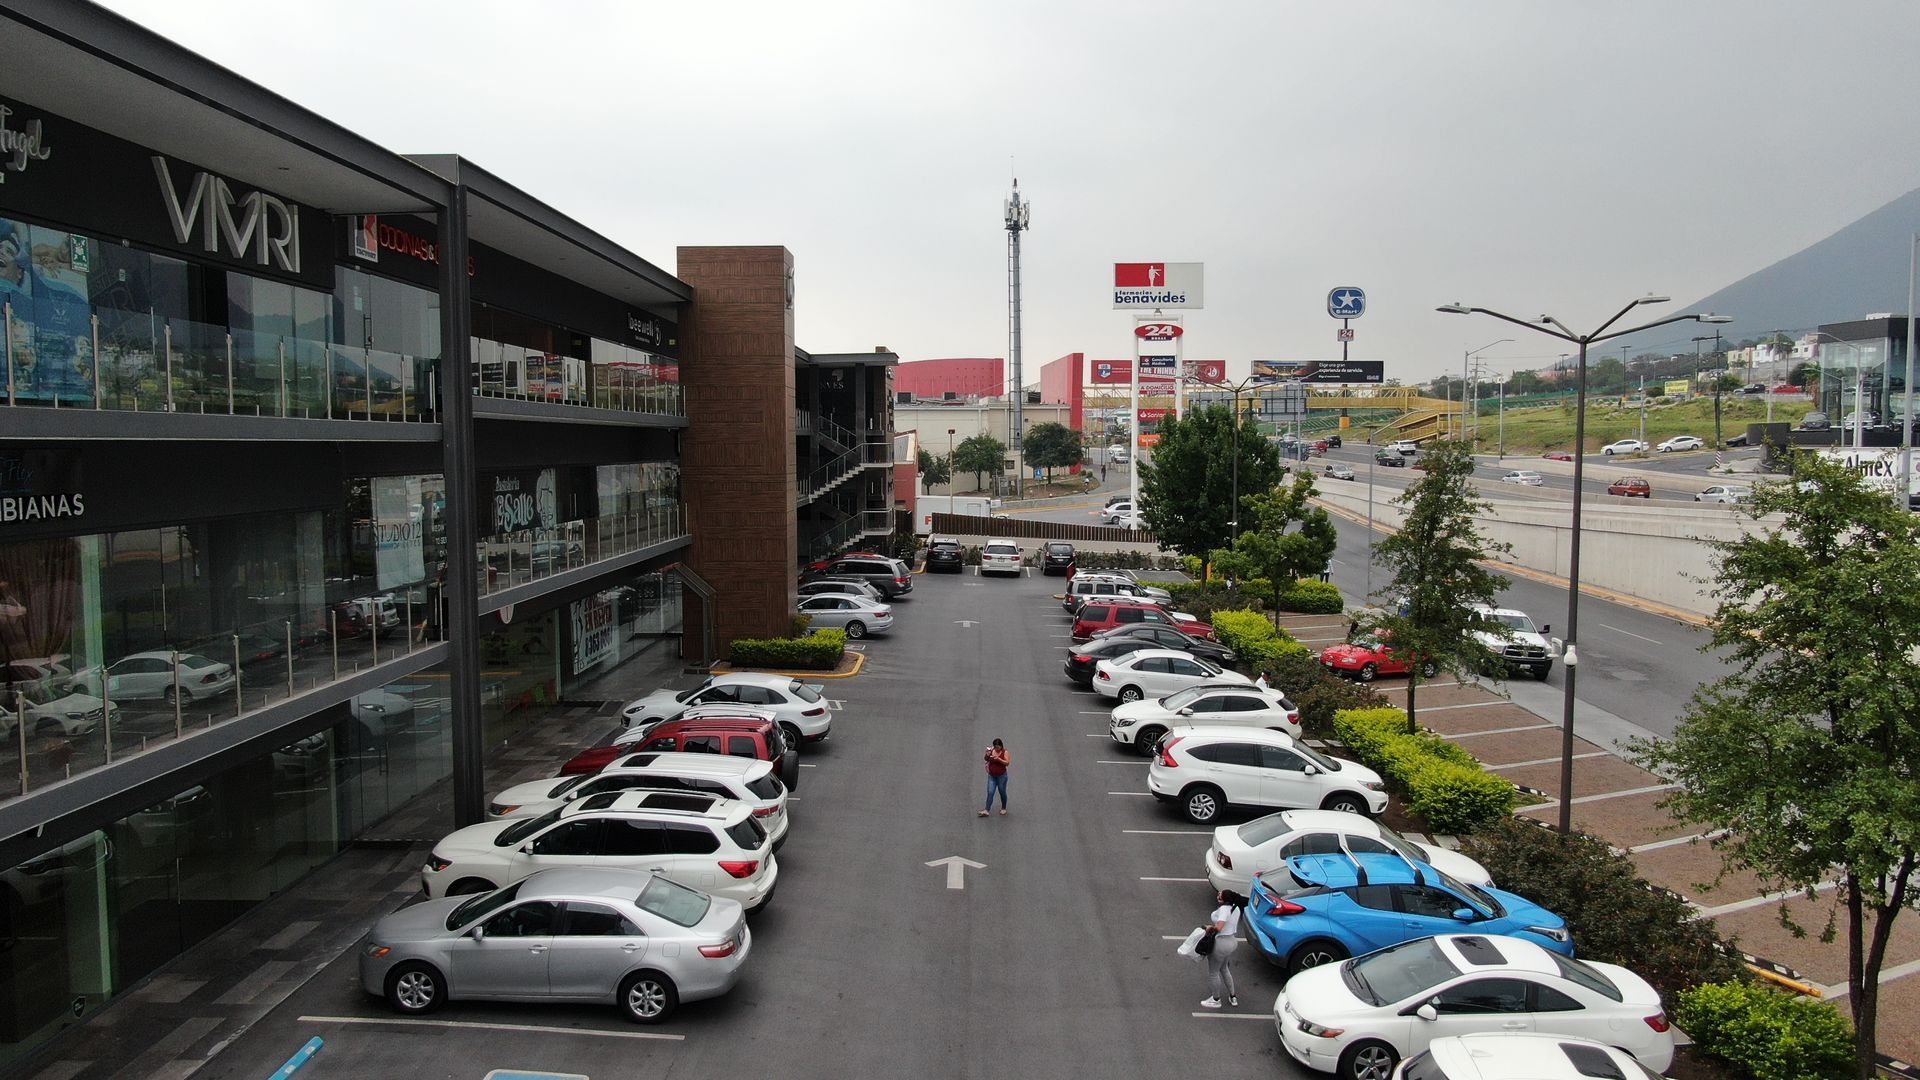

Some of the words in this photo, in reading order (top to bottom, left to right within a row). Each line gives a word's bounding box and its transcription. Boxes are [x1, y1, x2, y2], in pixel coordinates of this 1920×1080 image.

[1115, 291, 1186, 304] benavides
[1145, 325, 1174, 336] 24
[0, 494, 85, 521] BIANAS
